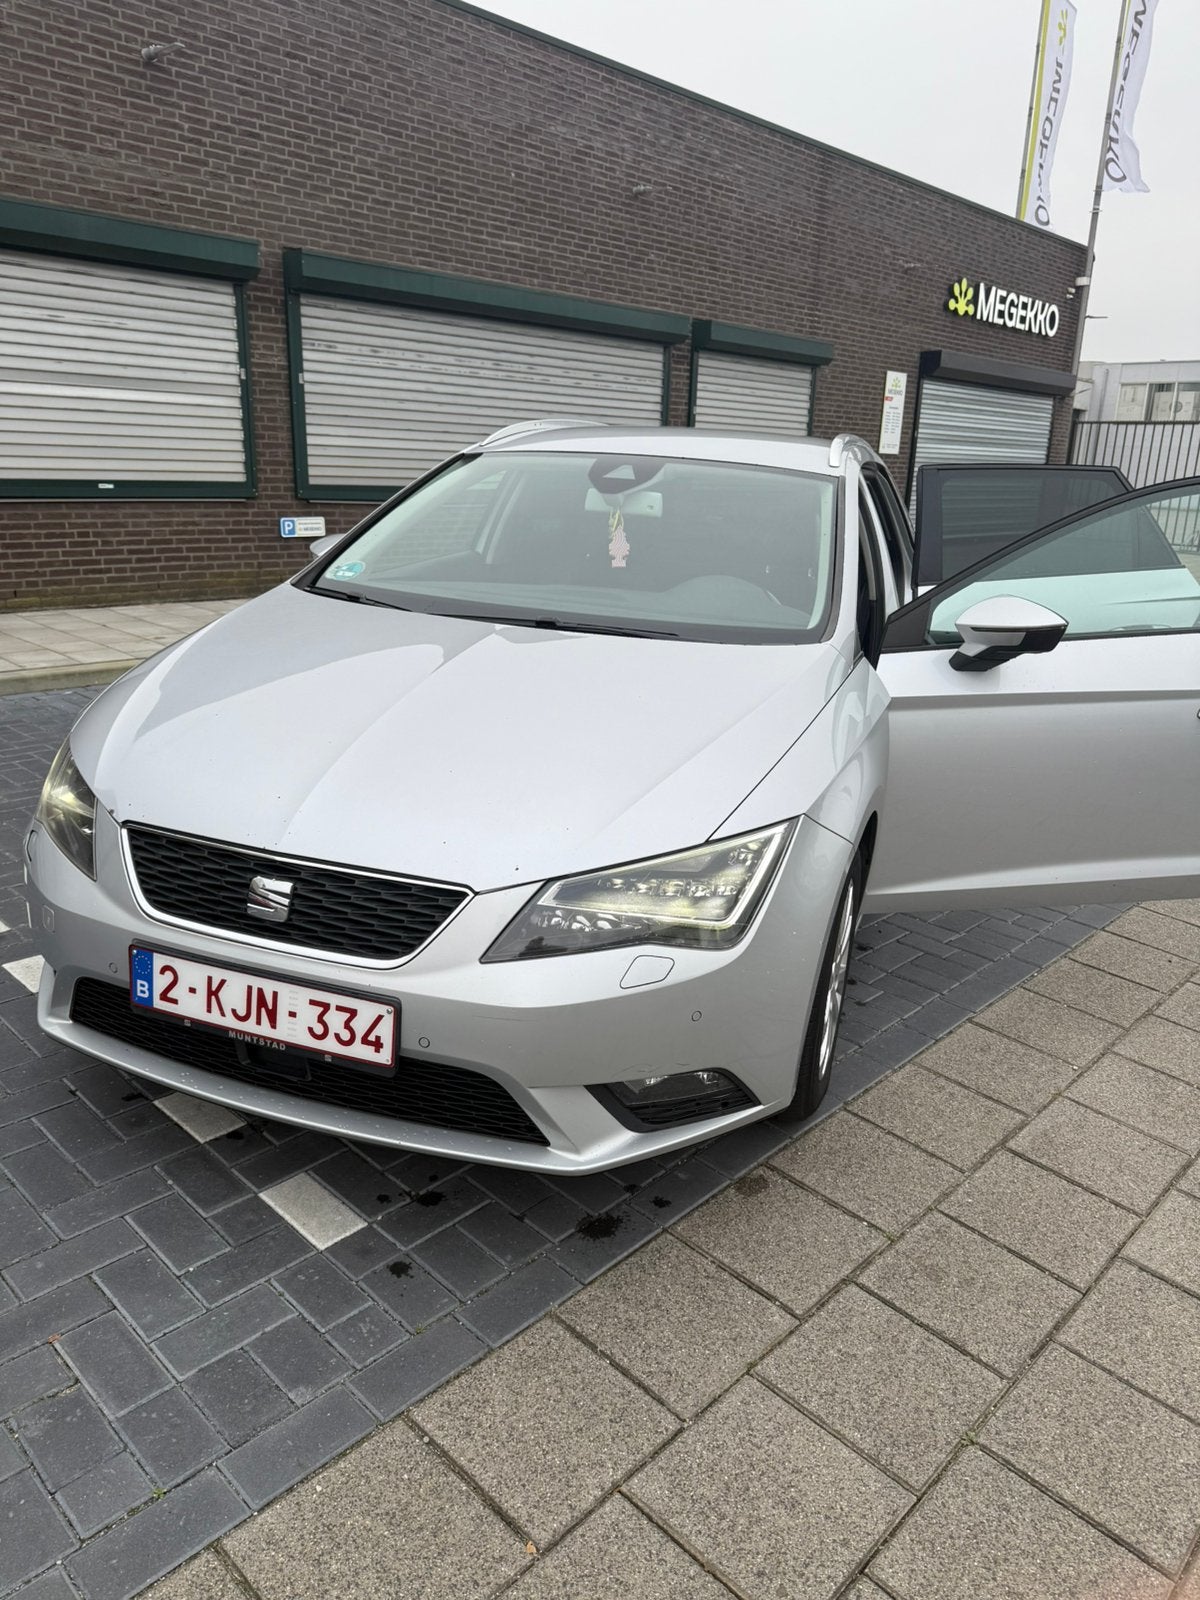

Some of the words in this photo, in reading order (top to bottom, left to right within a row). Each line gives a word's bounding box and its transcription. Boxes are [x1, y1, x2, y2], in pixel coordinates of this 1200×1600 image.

[976, 282, 1060, 337] MEGEKKO
[136, 979, 150, 998] B
[159, 964, 385, 1054] 2-KJN-334
[228, 1030, 287, 1051] MUNTSTAD
